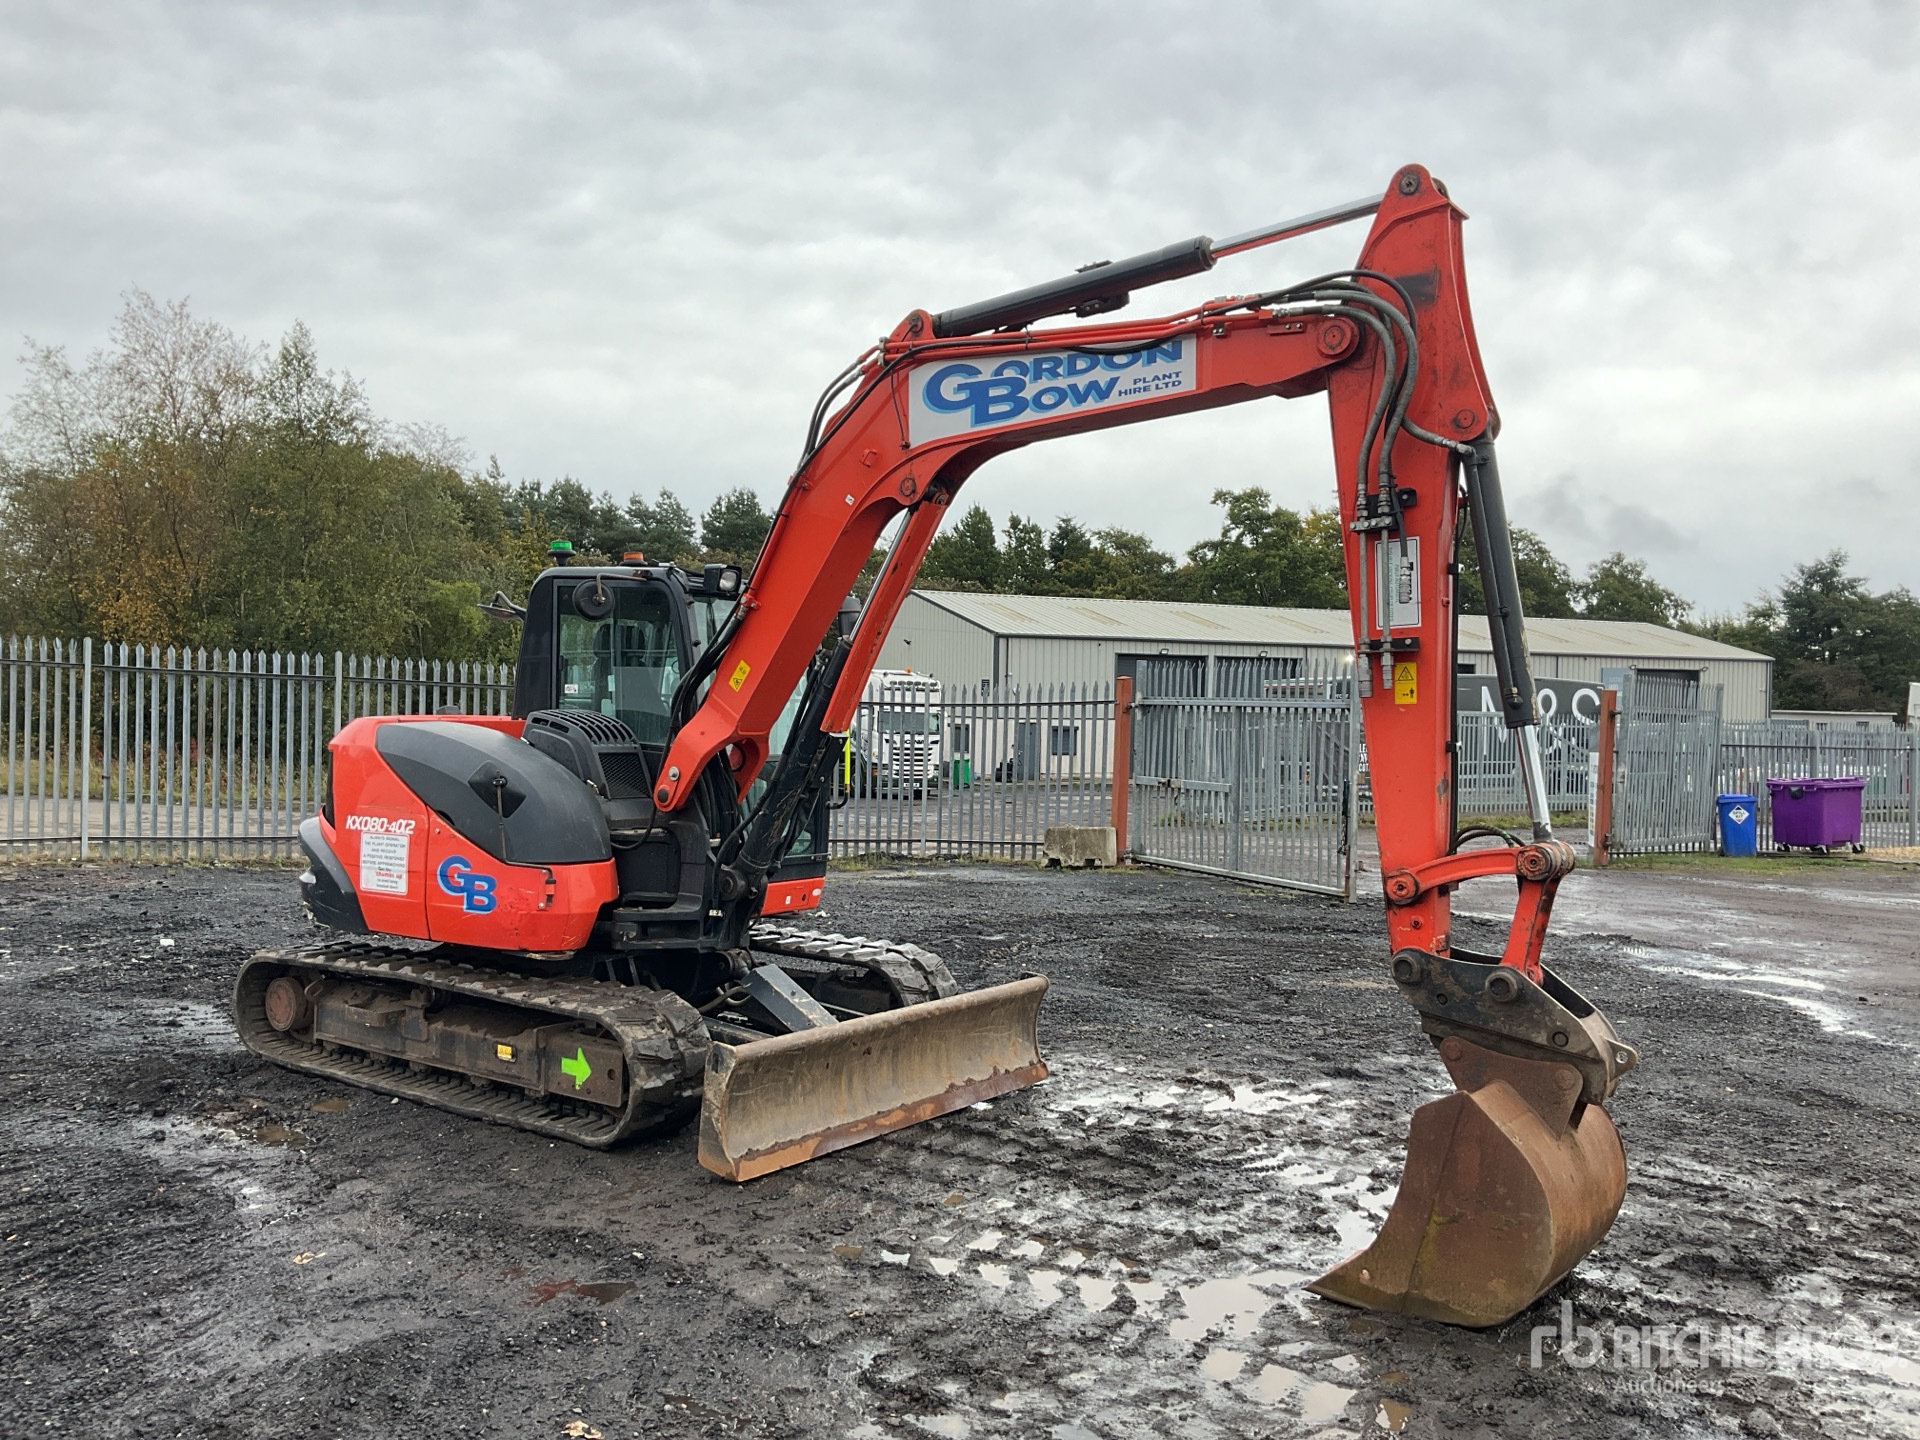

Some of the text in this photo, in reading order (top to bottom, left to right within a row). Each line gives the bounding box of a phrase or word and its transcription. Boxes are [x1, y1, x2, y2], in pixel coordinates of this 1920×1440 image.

[922, 340, 1182, 413] GORDON
[970, 375, 1121, 428] BOW
[1118, 380, 1182, 397] HIRE LTD
[1133, 371, 1182, 386] PLANT
[437, 855, 497, 914] GB
